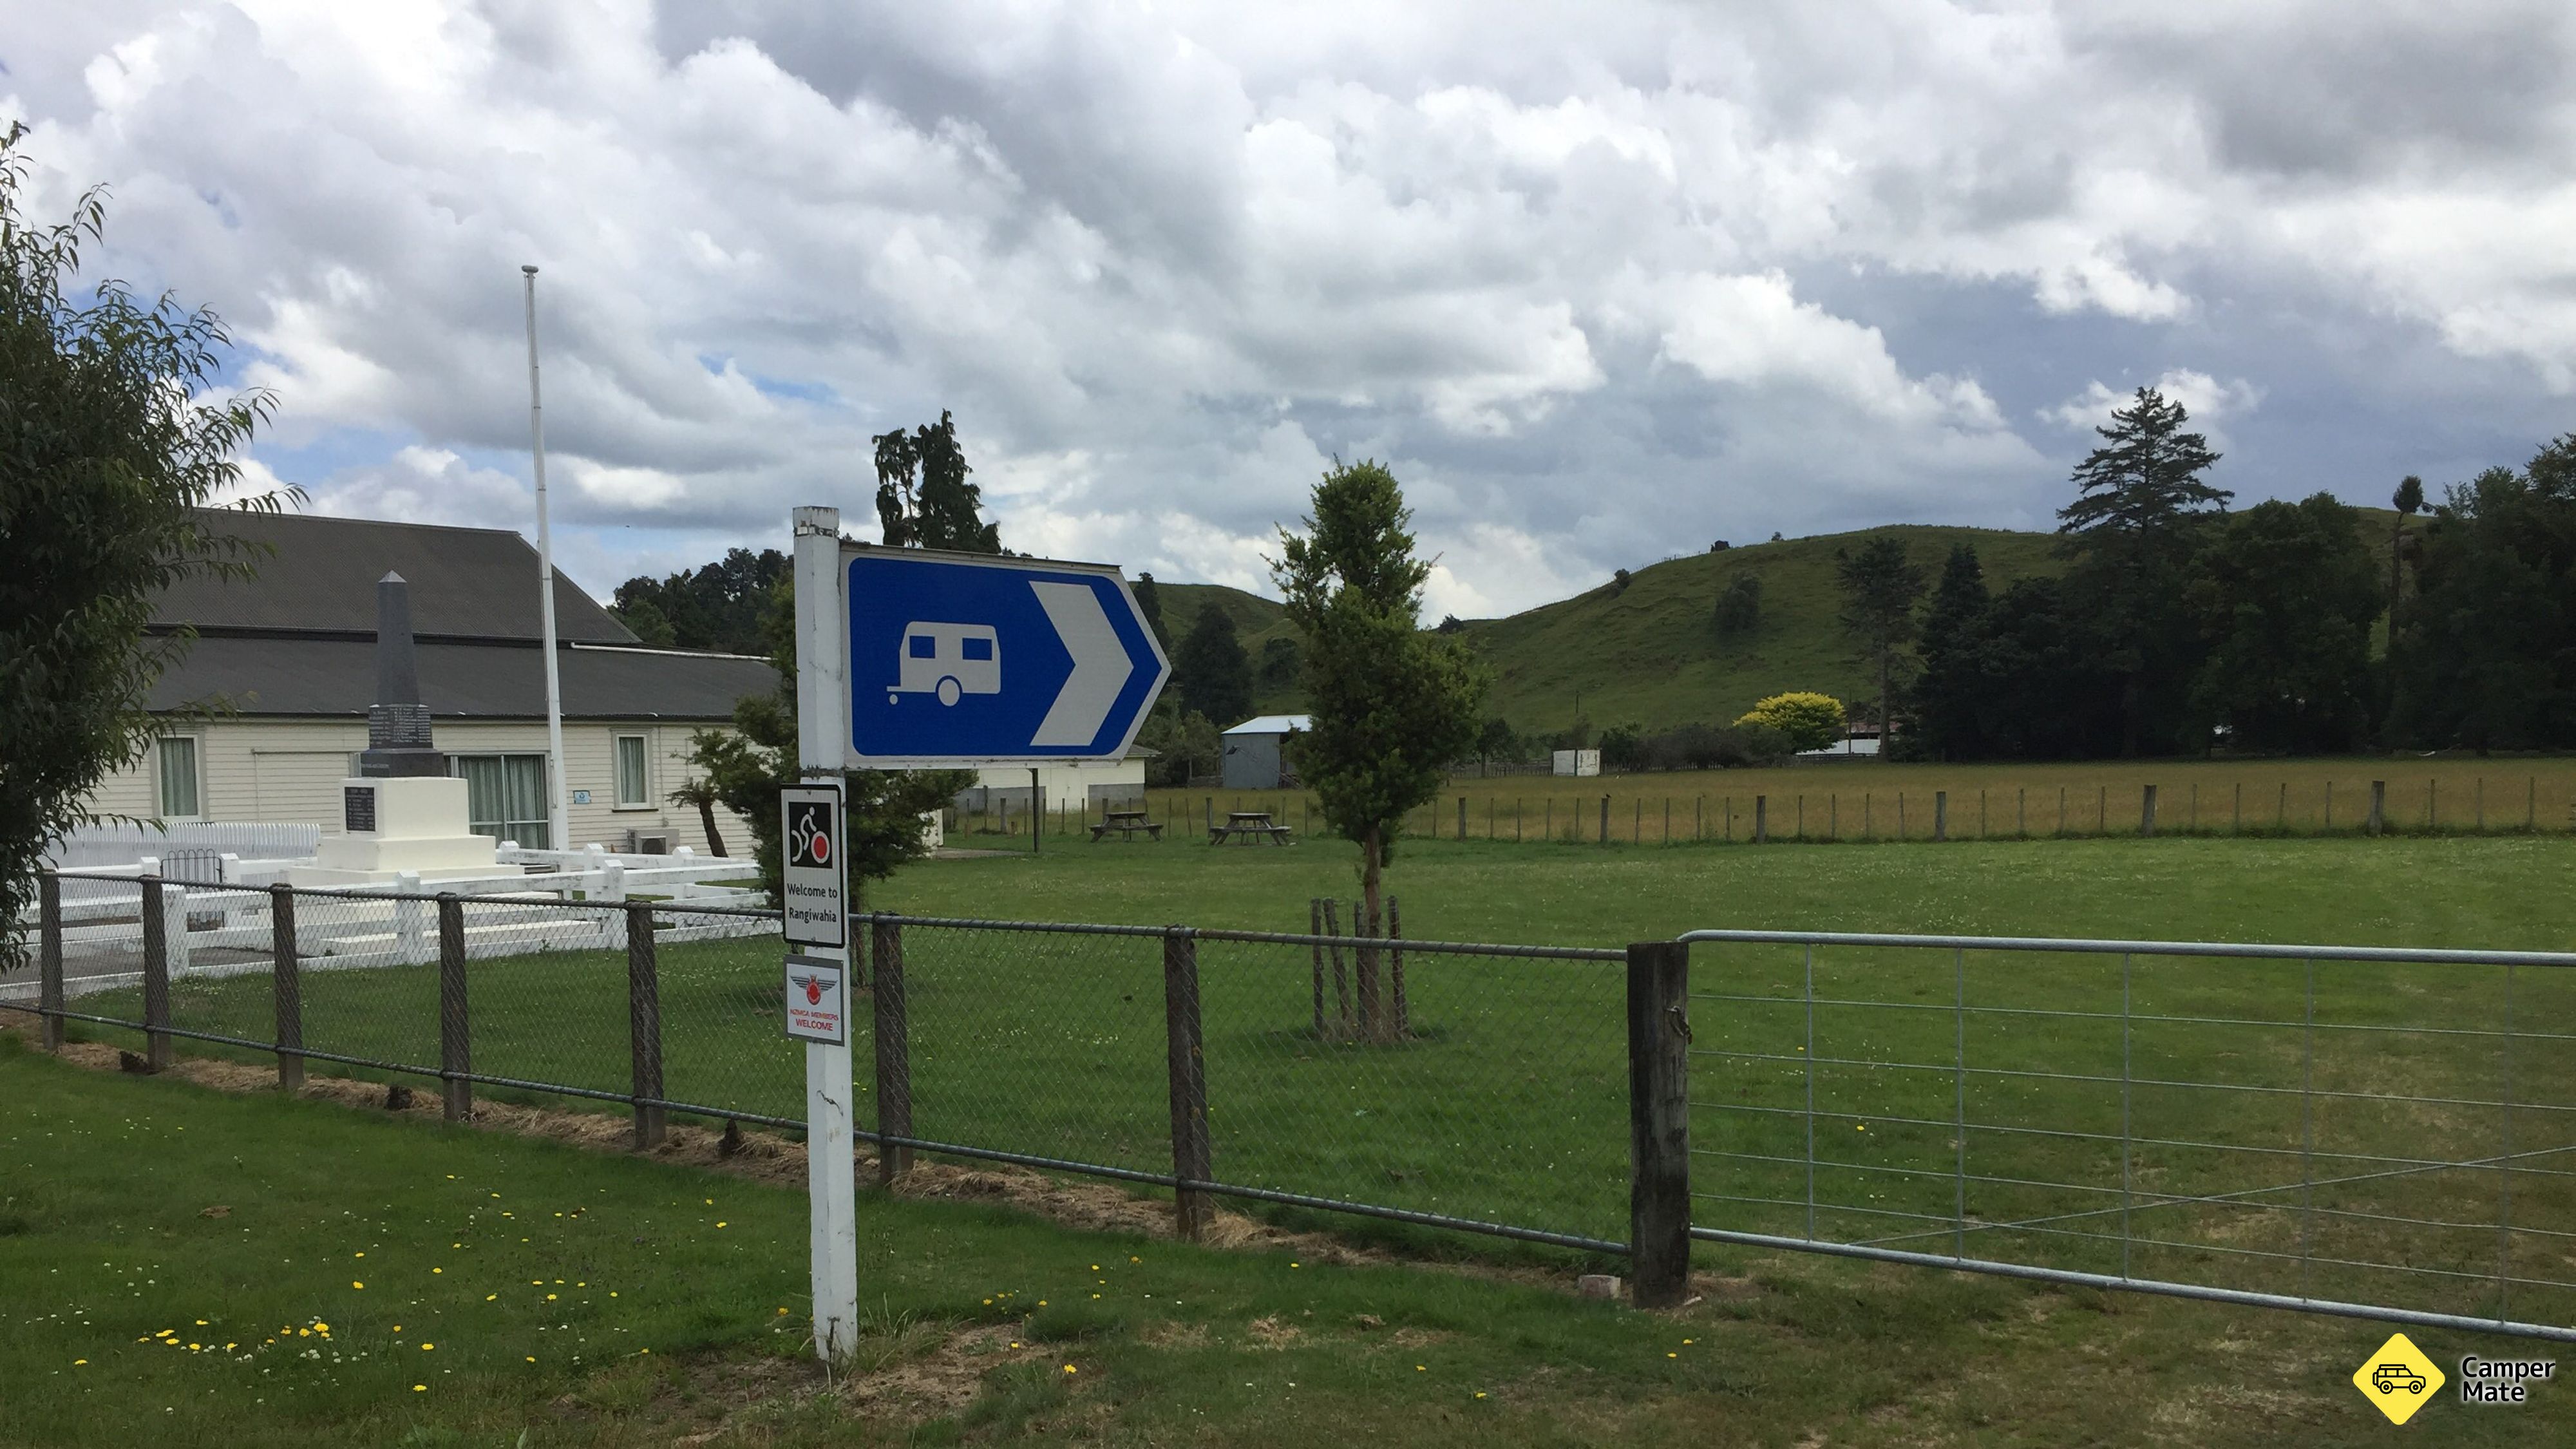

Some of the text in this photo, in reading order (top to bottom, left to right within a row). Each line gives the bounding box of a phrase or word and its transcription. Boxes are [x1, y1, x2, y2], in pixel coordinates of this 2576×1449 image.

[787, 883, 838, 898] Welcome to
[789, 907, 837, 923] Rangiwahia
[795, 1018, 833, 1031] WELCOME
